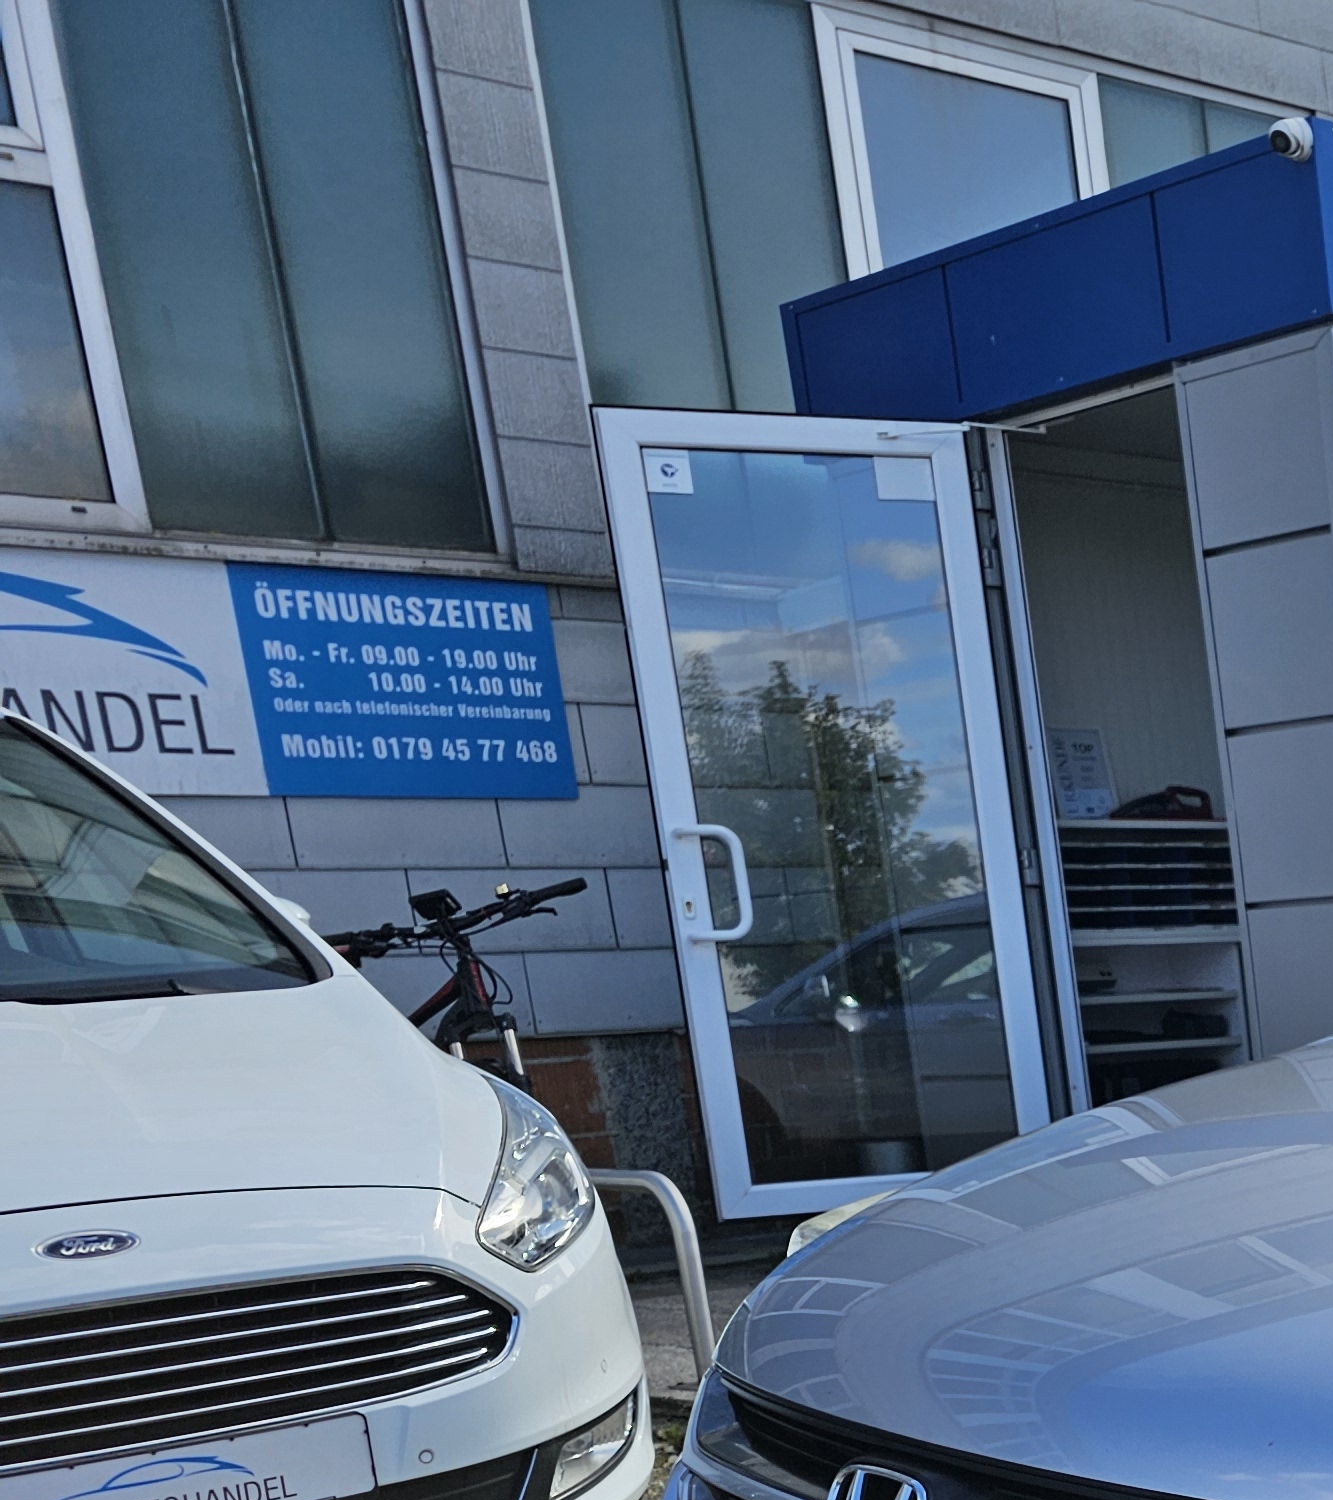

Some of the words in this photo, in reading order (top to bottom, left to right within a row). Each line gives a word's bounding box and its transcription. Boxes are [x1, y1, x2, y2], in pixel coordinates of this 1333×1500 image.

[254, 581, 534, 633] ÖFFNUNGSZEITEN
[262, 640, 305, 662] Mo.
[327, 642, 355, 665] Fr.
[361, 645, 420, 668] 09.00
[443, 648, 497, 670] 19.00
[503, 652, 537, 672] Uhr
[268, 667, 305, 690] Sa.
[368, 672, 426, 694] 10.00
[449, 675, 503, 697] 14.00
[510, 678, 543, 698] Uhr
[273, 696, 309, 713] Oder
[314, 699, 351, 715] nach
[356, 700, 453, 718] telefonischer
[458, 703, 551, 722] Vereinbarung
[281, 733, 364, 760] Mobil:
[372, 736, 433, 761] 0179
[441, 738, 470, 762] 45
[477, 739, 506, 762] 77
[515, 740, 558, 763] 468
[60, 1236, 116, 1256] Ford
